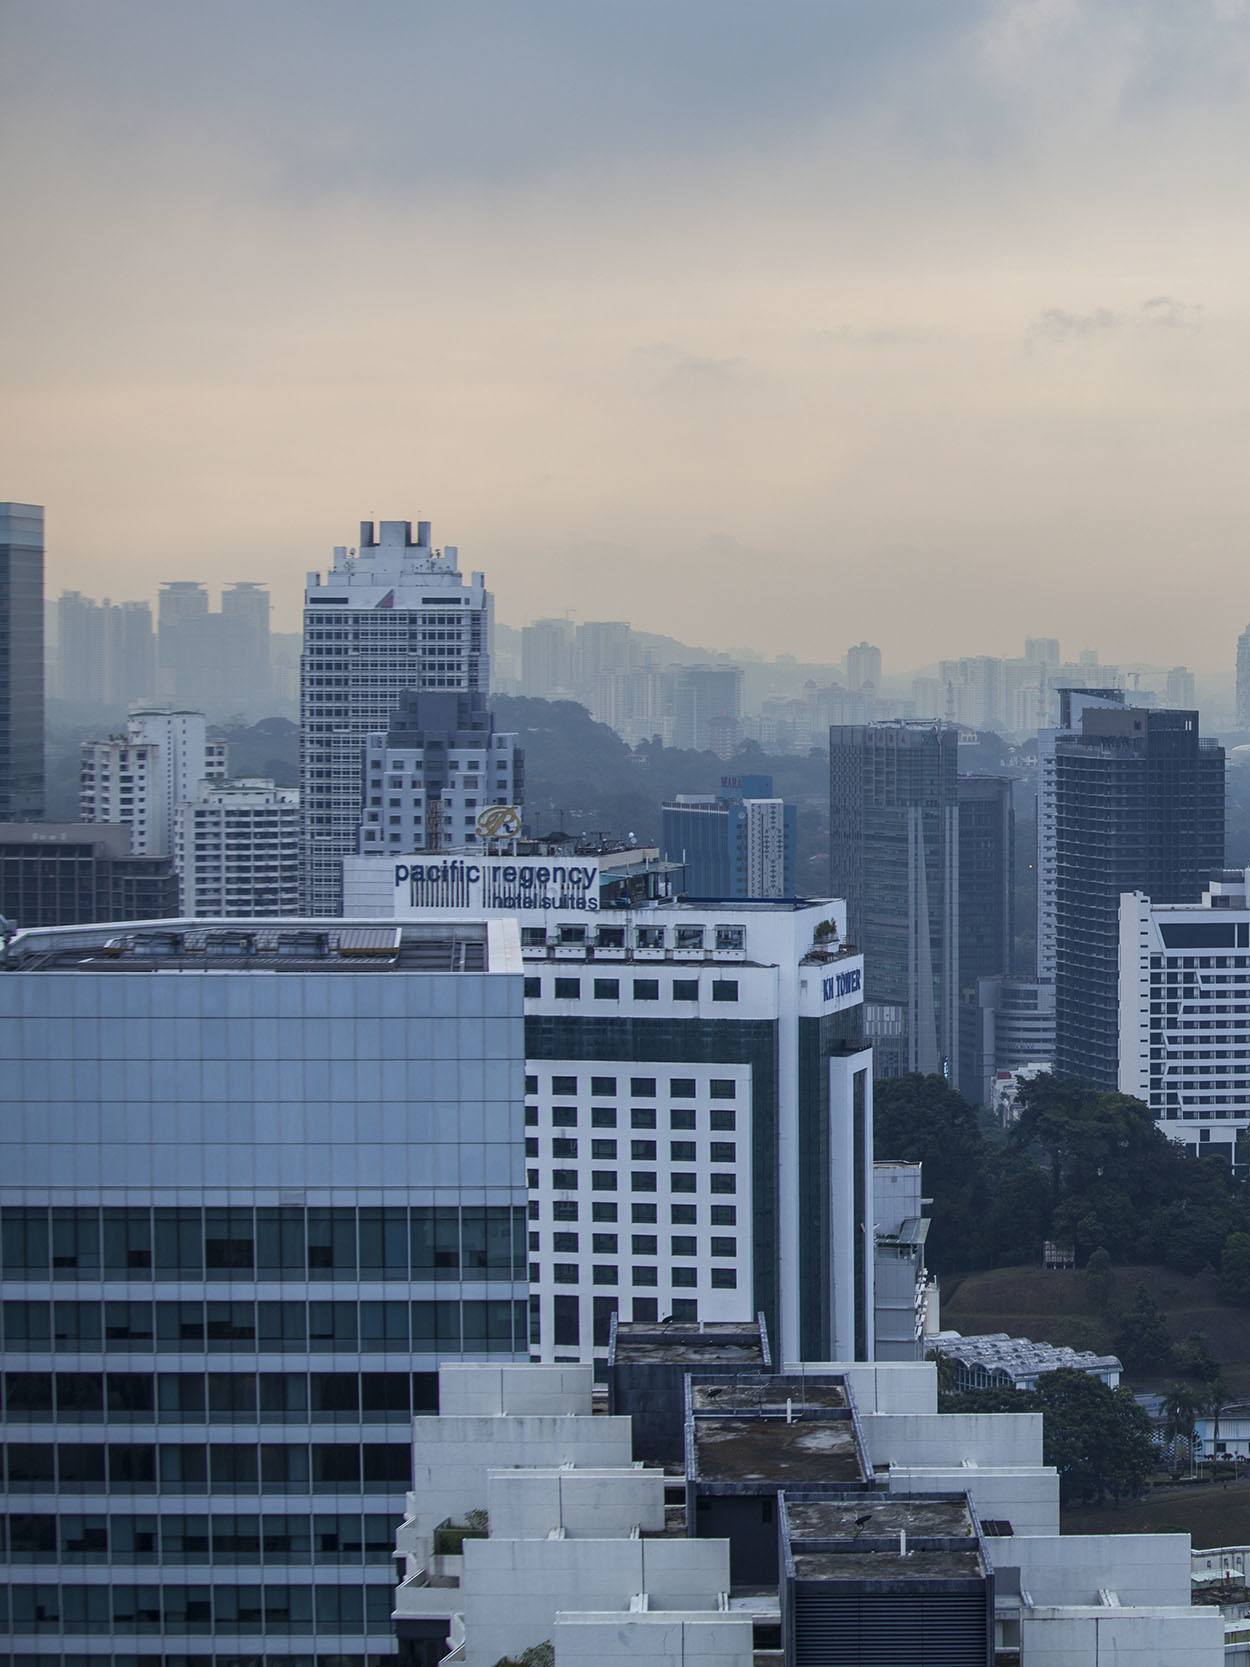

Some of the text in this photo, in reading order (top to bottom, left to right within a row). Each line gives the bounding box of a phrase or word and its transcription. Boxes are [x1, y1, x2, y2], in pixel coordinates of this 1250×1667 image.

[395, 860, 598, 890] pacific regency
[542, 893, 598, 910] suites
[823, 969, 861, 1002] KH TOWER
